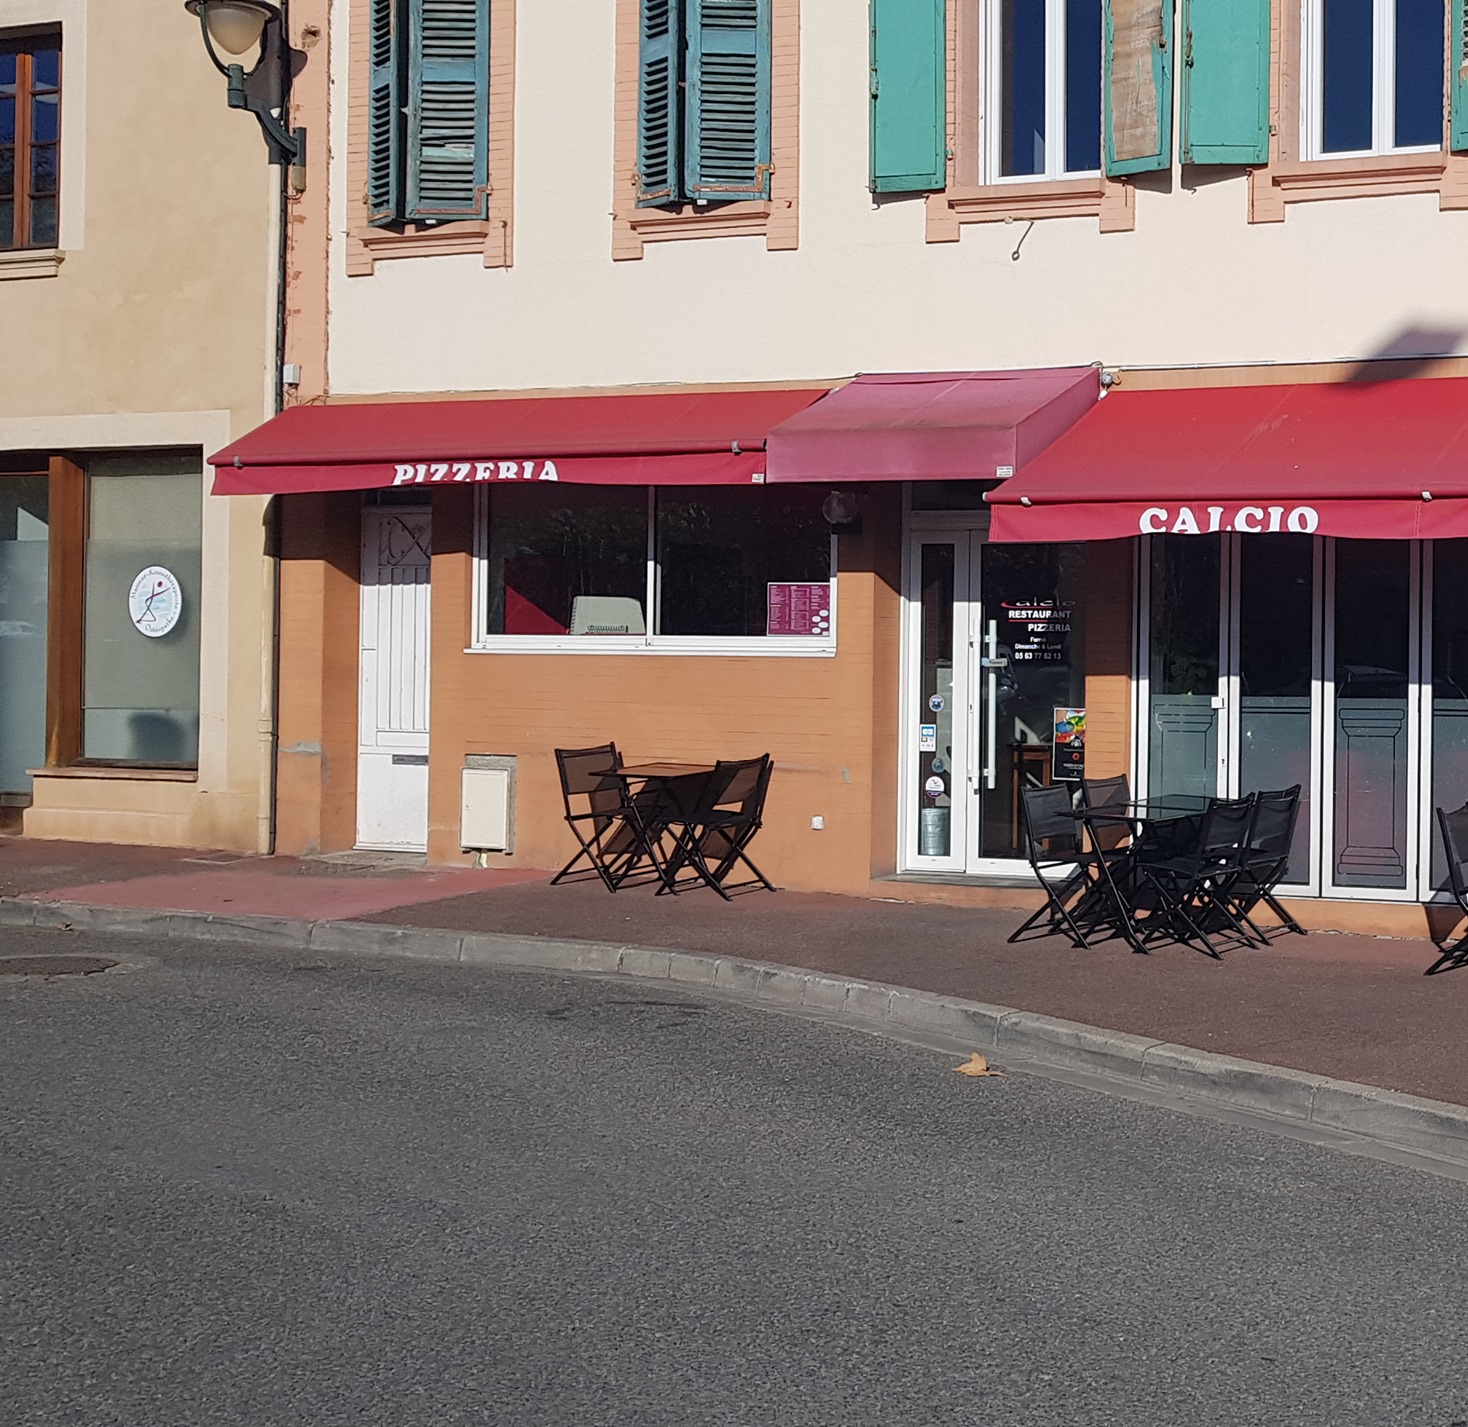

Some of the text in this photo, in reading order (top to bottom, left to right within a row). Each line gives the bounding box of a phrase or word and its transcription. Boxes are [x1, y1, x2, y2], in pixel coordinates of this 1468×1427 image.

[391, 460, 559, 486] PIZZERIA
[1139, 506, 1319, 535] CALCIO
[1008, 610, 1071, 619] RESTAURANT
[1028, 623, 1071, 632] PIZZERIA
[1015, 652, 1023, 660] 05
[1034, 652, 1042, 660] 77
